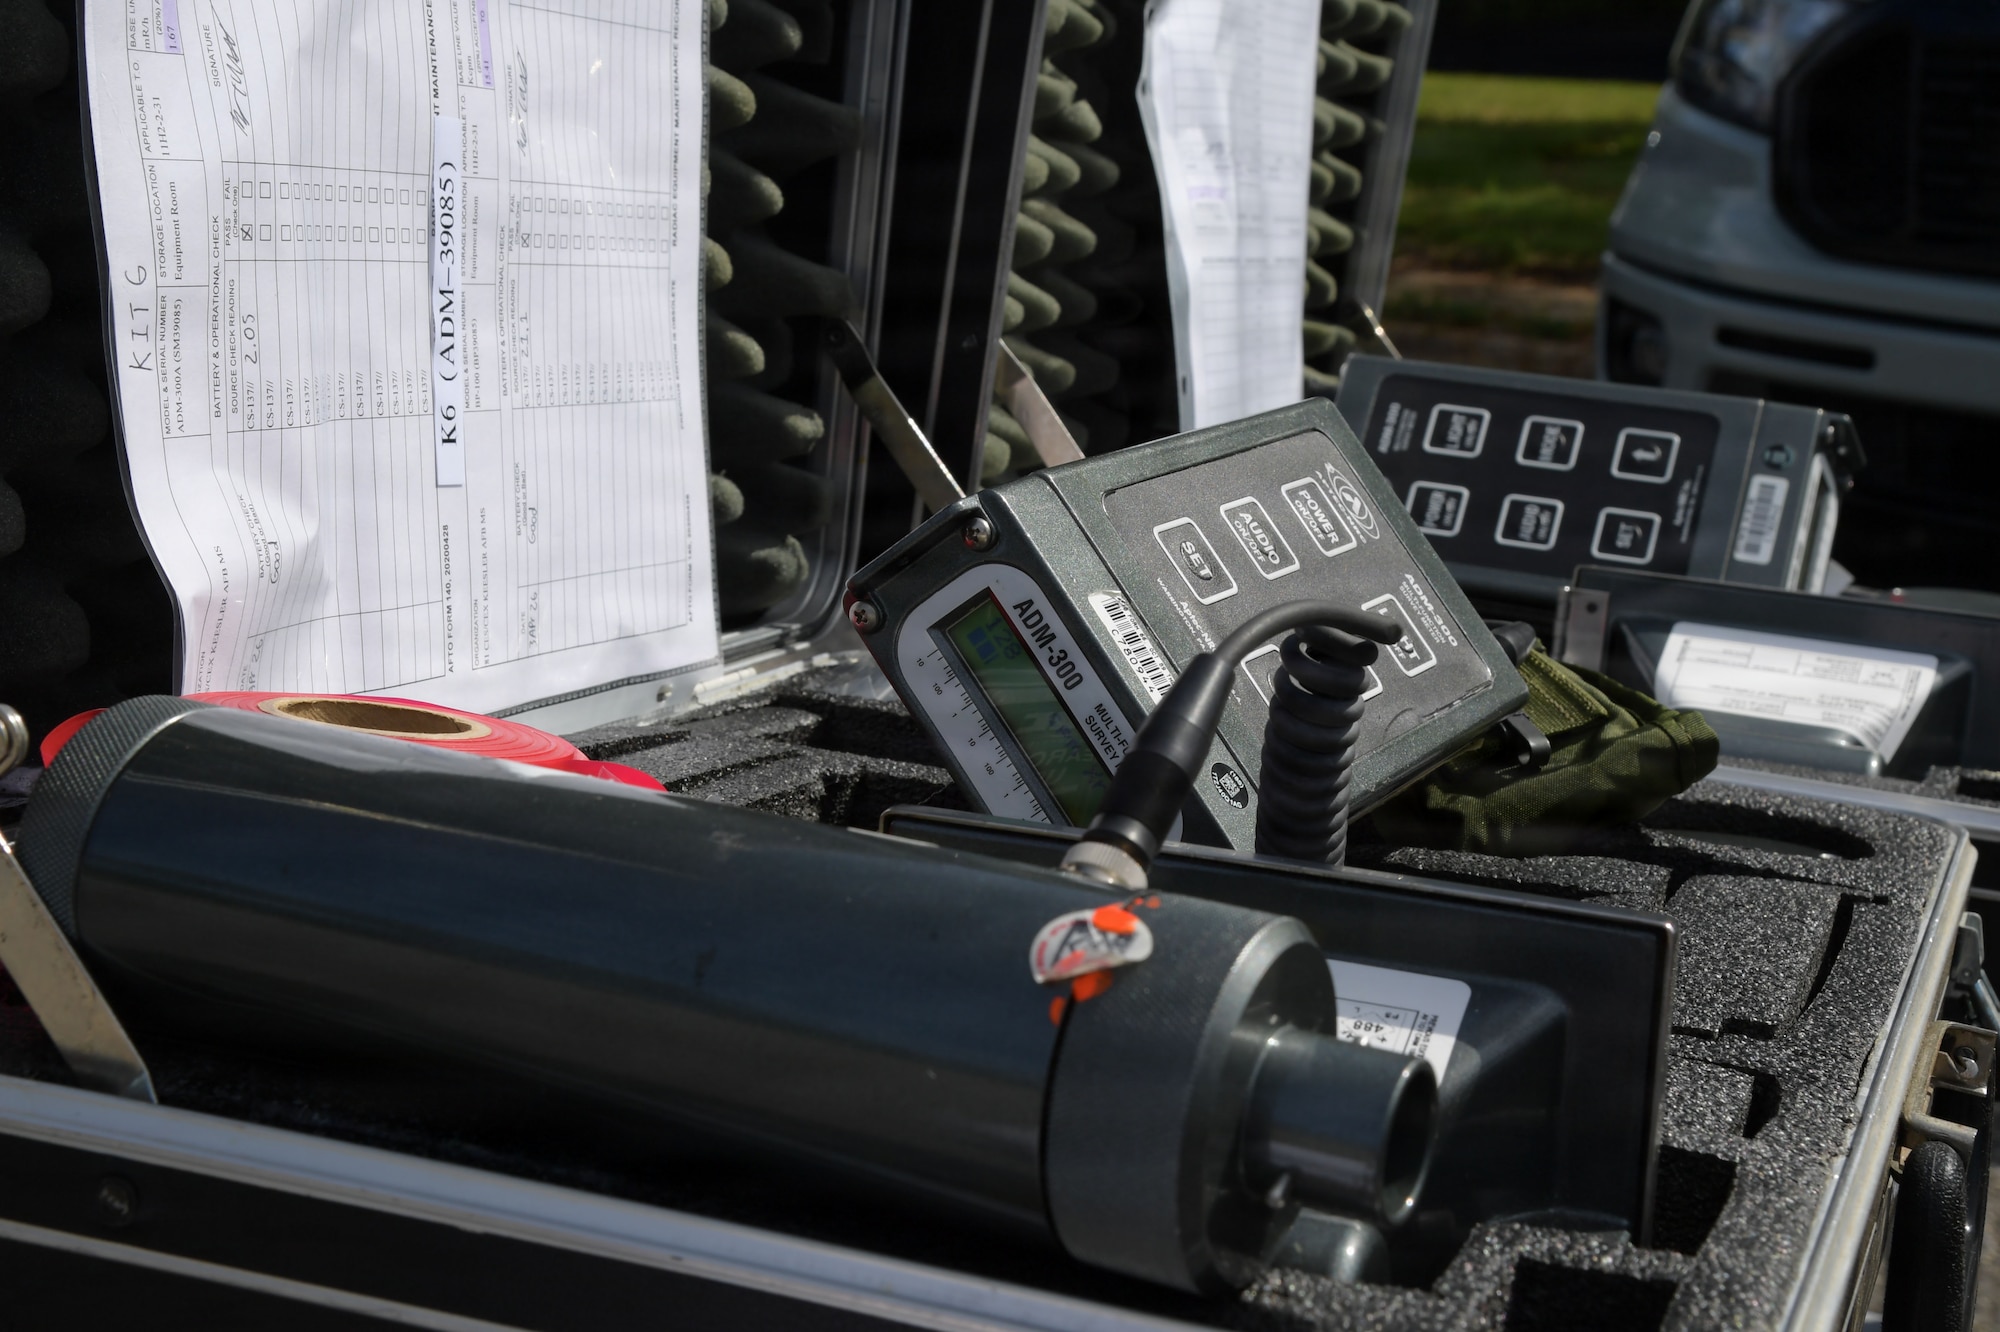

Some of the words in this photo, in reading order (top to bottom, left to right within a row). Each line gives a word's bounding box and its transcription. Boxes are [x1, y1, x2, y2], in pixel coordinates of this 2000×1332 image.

[129, 17, 137, 48] BASE
[142, 17, 151, 49] mR/h
[167, 25, 177, 49] 1.67
[452, 1, 460, 32] VALUE
[202, 24, 221, 87] SIGNATURE
[454, 35, 462, 56] LINE
[456, 59, 464, 84] BASE
[135, 84, 152, 152] APPLICABLE
[460, 114, 468, 172] APPLICABLE
[147, 164, 163, 221] LOCATION
[168, 181, 179, 215] Room
[471, 195, 479, 225] Room
[155, 223, 167, 278] STORAGE
[172, 218, 184, 281] Equipment
[211, 215, 220, 259] CHECK
[224, 217, 232, 247] PASS
[471, 227, 479, 281] Equipment
[160, 295, 168, 343] NUMBER
[211, 261, 220, 348] OPERATIONAL
[228, 278, 236, 327] READING
[173, 298, 183, 363] (SM39085)
[229, 329, 238, 367] CHECK
[160, 345, 168, 383] SERIAL
[174, 366, 185, 433] ADM-300A
[212, 362, 222, 418] BATTERY
[230, 369, 239, 414] SOURCE
[163, 396, 172, 435] MODEL
[440, 405, 457, 444] K6
[1239, 512, 1280, 565] AUDIO
[1294, 500, 1325, 541] ON/OFF
[1298, 489, 1339, 544] POWER
[213, 545, 226, 564] MS
[1181, 541, 1213, 579] SET
[1234, 520, 1265, 563] ON/OFF
[220, 567, 229, 594] AFB
[210, 597, 228, 655] KEESLER
[445, 605, 453, 639] FORM
[1399, 585, 1422, 615] SURVEY
[1421, 617, 1441, 643] METER
[1401, 581, 1447, 644] MULTI-FUNCTION
[1404, 573, 1458, 647] ADM-300
[986, 617, 1021, 660] 128
[1012, 599, 1084, 691] ADM-300
[1378, 607, 1420, 660] LHT
[1111, 629, 1155, 693] C780944
[916, 658, 925, 667] 10
[932, 682, 943, 696] 100
[967, 737, 976, 747] 10
[984, 762, 994, 776] 100
[1085, 715, 1119, 760] SURVEY
[1353, 1020, 1384, 1033] 488
